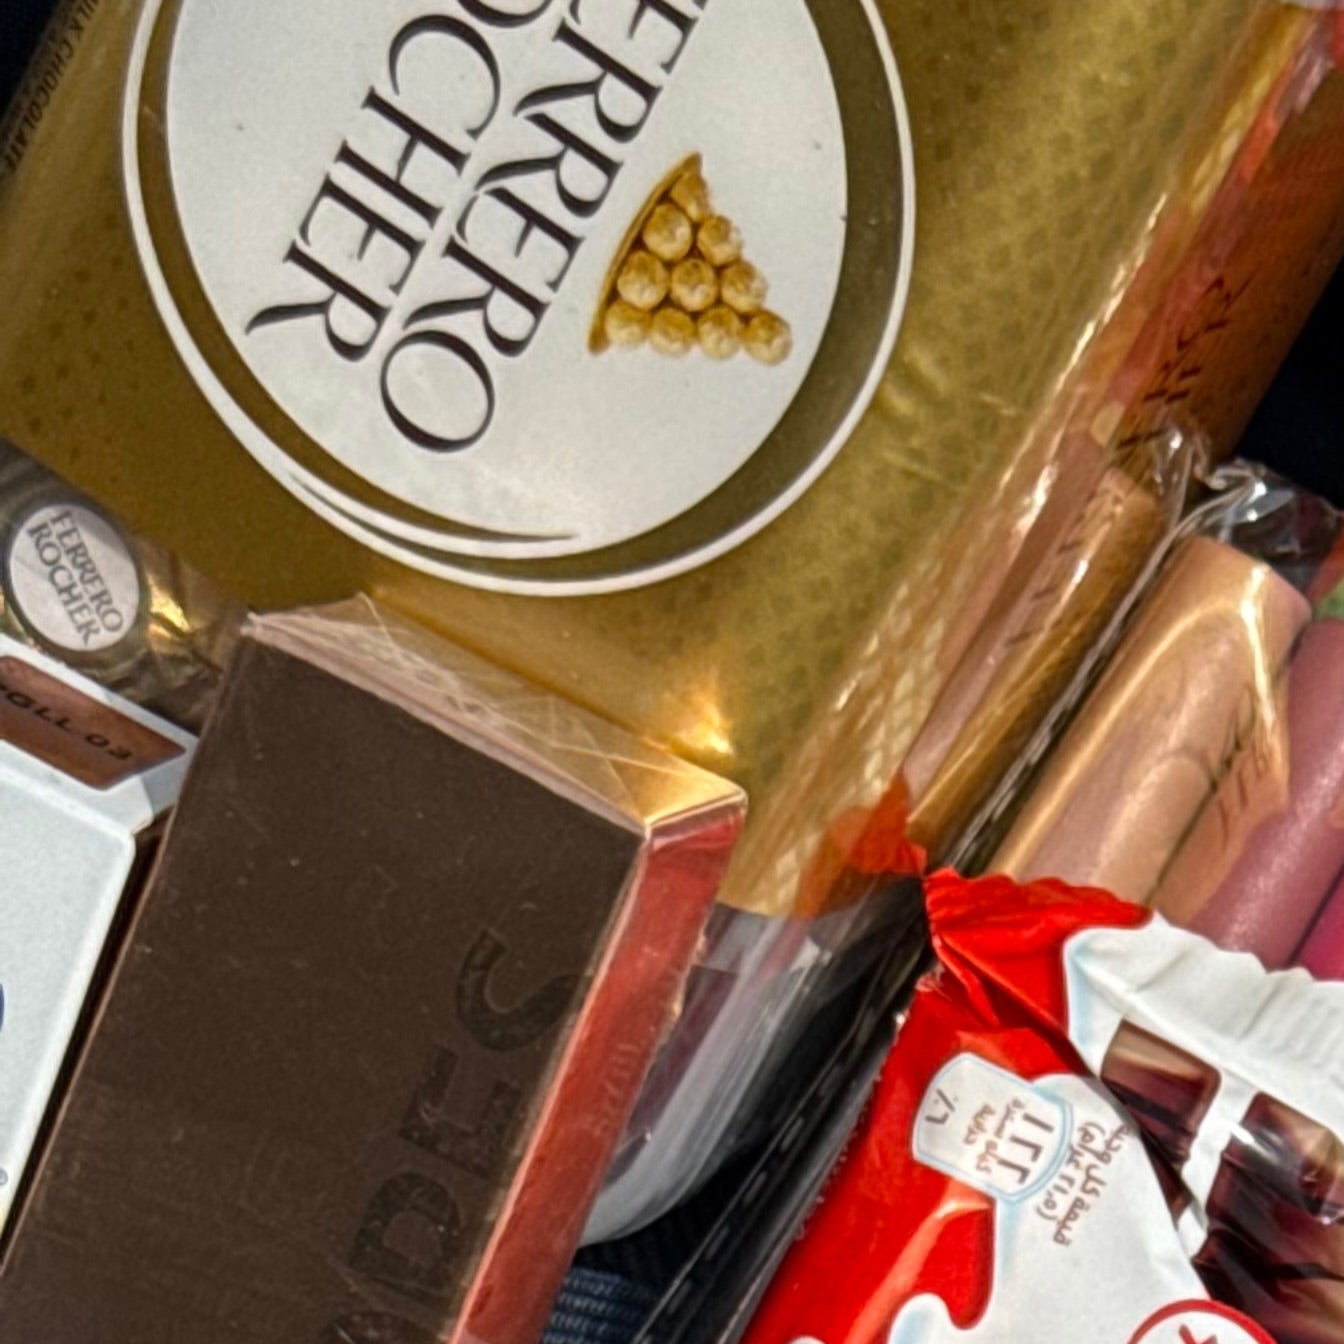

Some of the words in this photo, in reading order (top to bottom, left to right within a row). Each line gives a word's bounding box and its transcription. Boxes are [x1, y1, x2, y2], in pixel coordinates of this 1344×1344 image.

[379, 0, 707, 453] ERRERO
[27, 524, 104, 646] ROCHER
[50, 511, 126, 637] FERRERO
